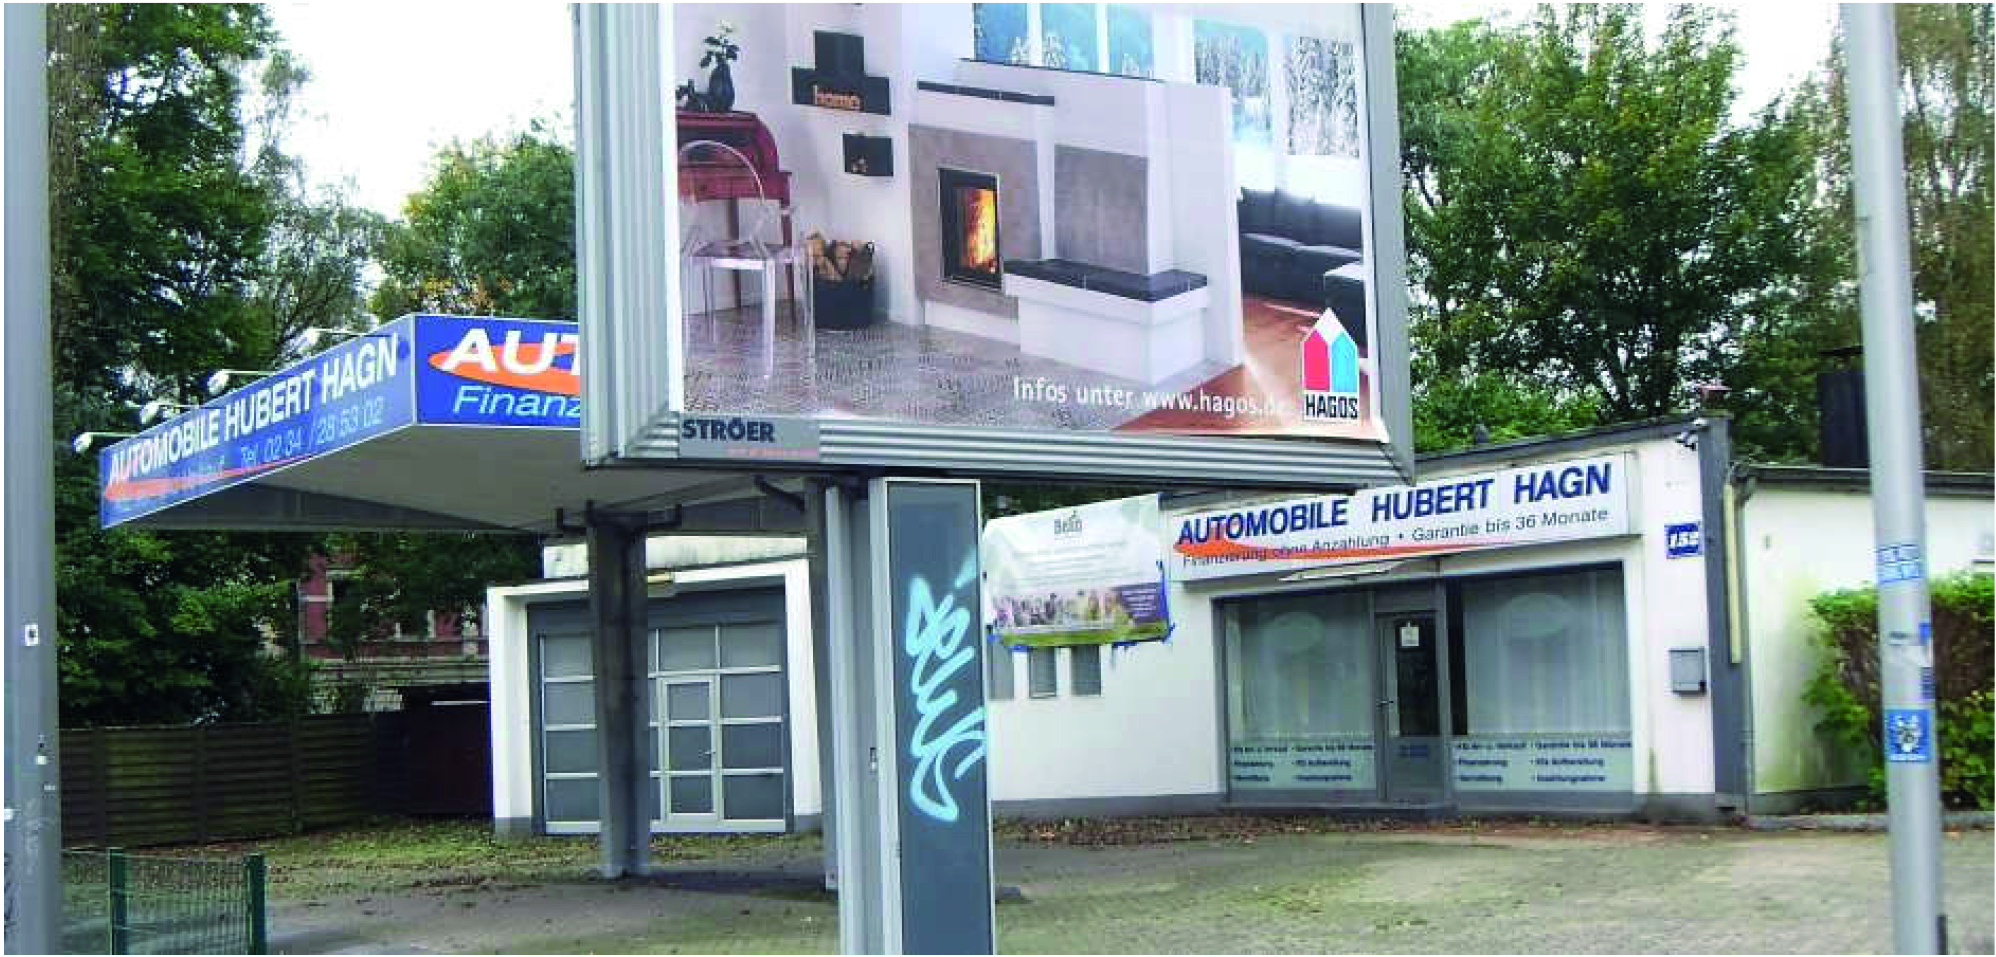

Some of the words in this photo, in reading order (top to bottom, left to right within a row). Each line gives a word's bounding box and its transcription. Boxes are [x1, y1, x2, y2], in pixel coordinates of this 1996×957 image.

[1013, 376, 1068, 403] Infos
[1076, 384, 1133, 409] unter
[1305, 394, 1359, 419] HAGOS
[109, 408, 221, 488] AUTOMOBILE
[224, 369, 316, 440] HUBERT
[322, 332, 398, 404] HAGN
[681, 417, 776, 443] STRÖER
[1177, 498, 1349, 546] AUTOMOBILE
[1371, 478, 1494, 522] HUBERT
[1514, 462, 1612, 504] HAGN
[1412, 522, 1479, 542] Garantie
[1486, 517, 1511, 533] bis
[1515, 514, 1537, 530] 36
[1541, 509, 1609, 526] Monate
